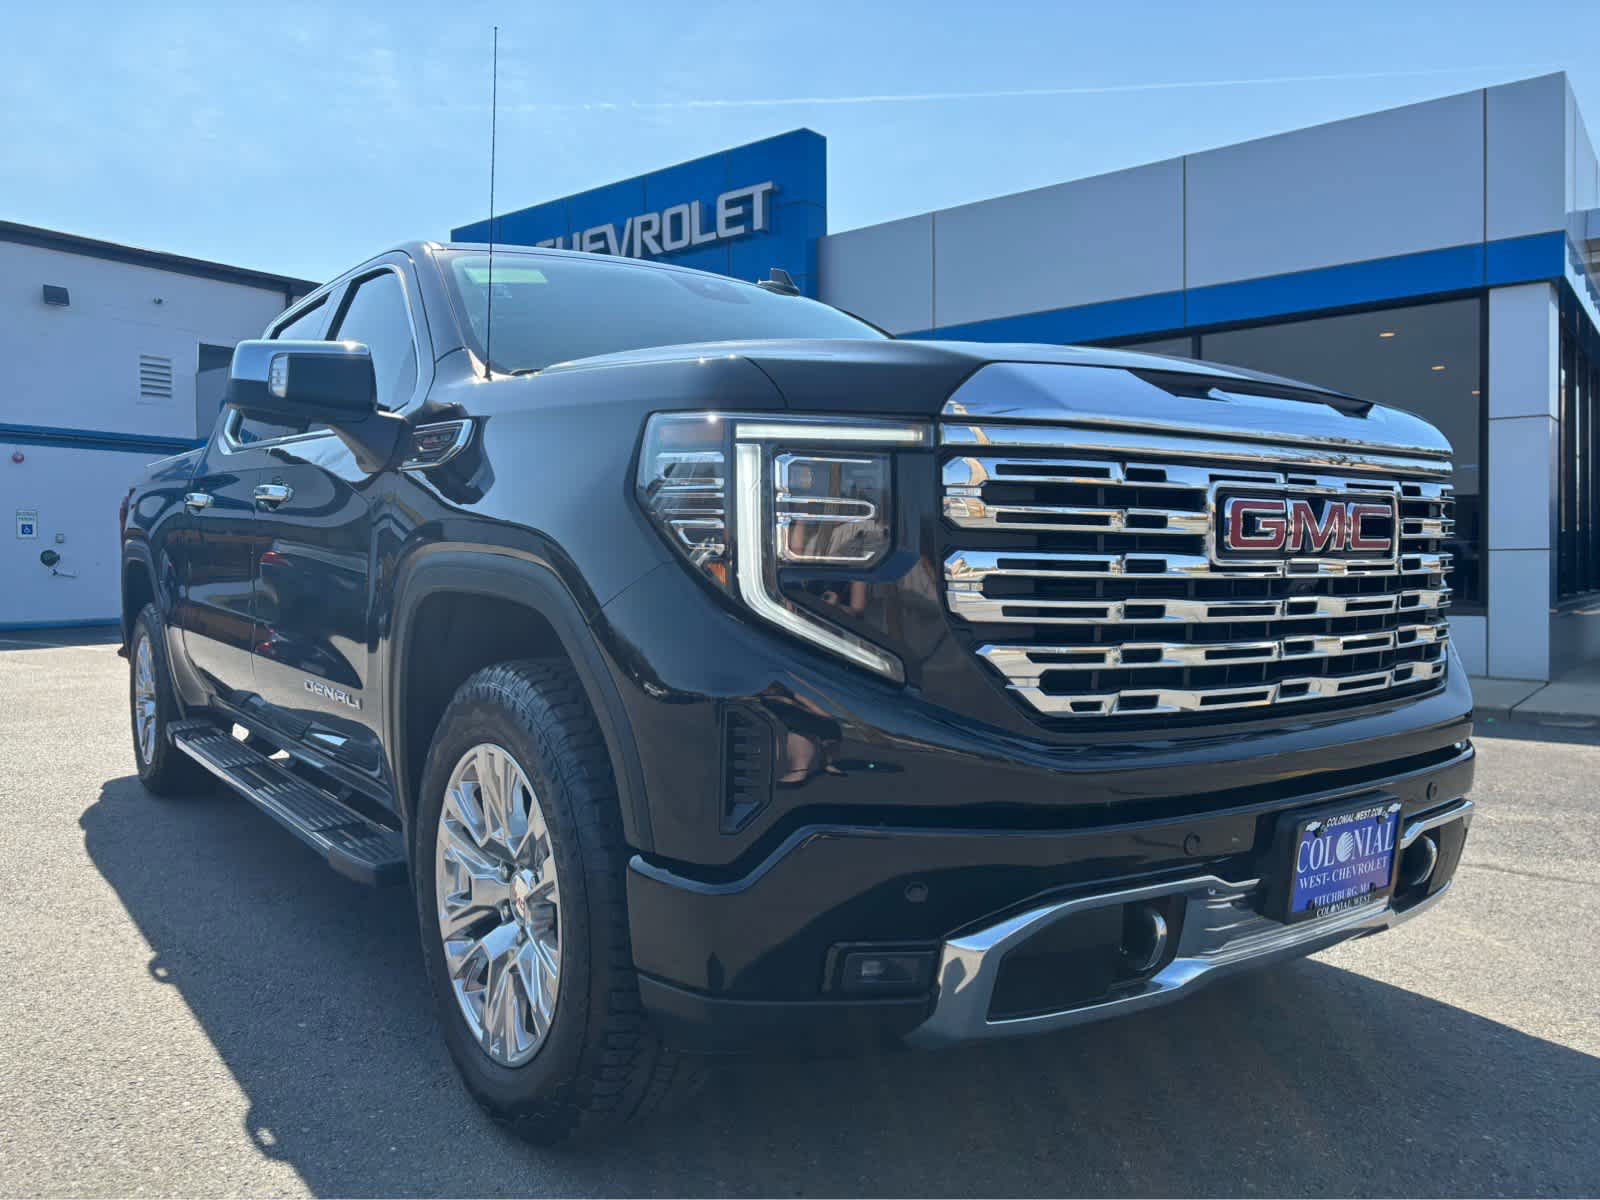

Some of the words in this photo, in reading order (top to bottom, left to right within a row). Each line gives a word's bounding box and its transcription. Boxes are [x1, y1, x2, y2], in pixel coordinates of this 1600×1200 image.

[536, 181, 774, 258] EVROLET
[1224, 497, 1392, 551] GMC
[303, 679, 362, 710] DENALI
[1296, 822, 1394, 873] COLONIAL
